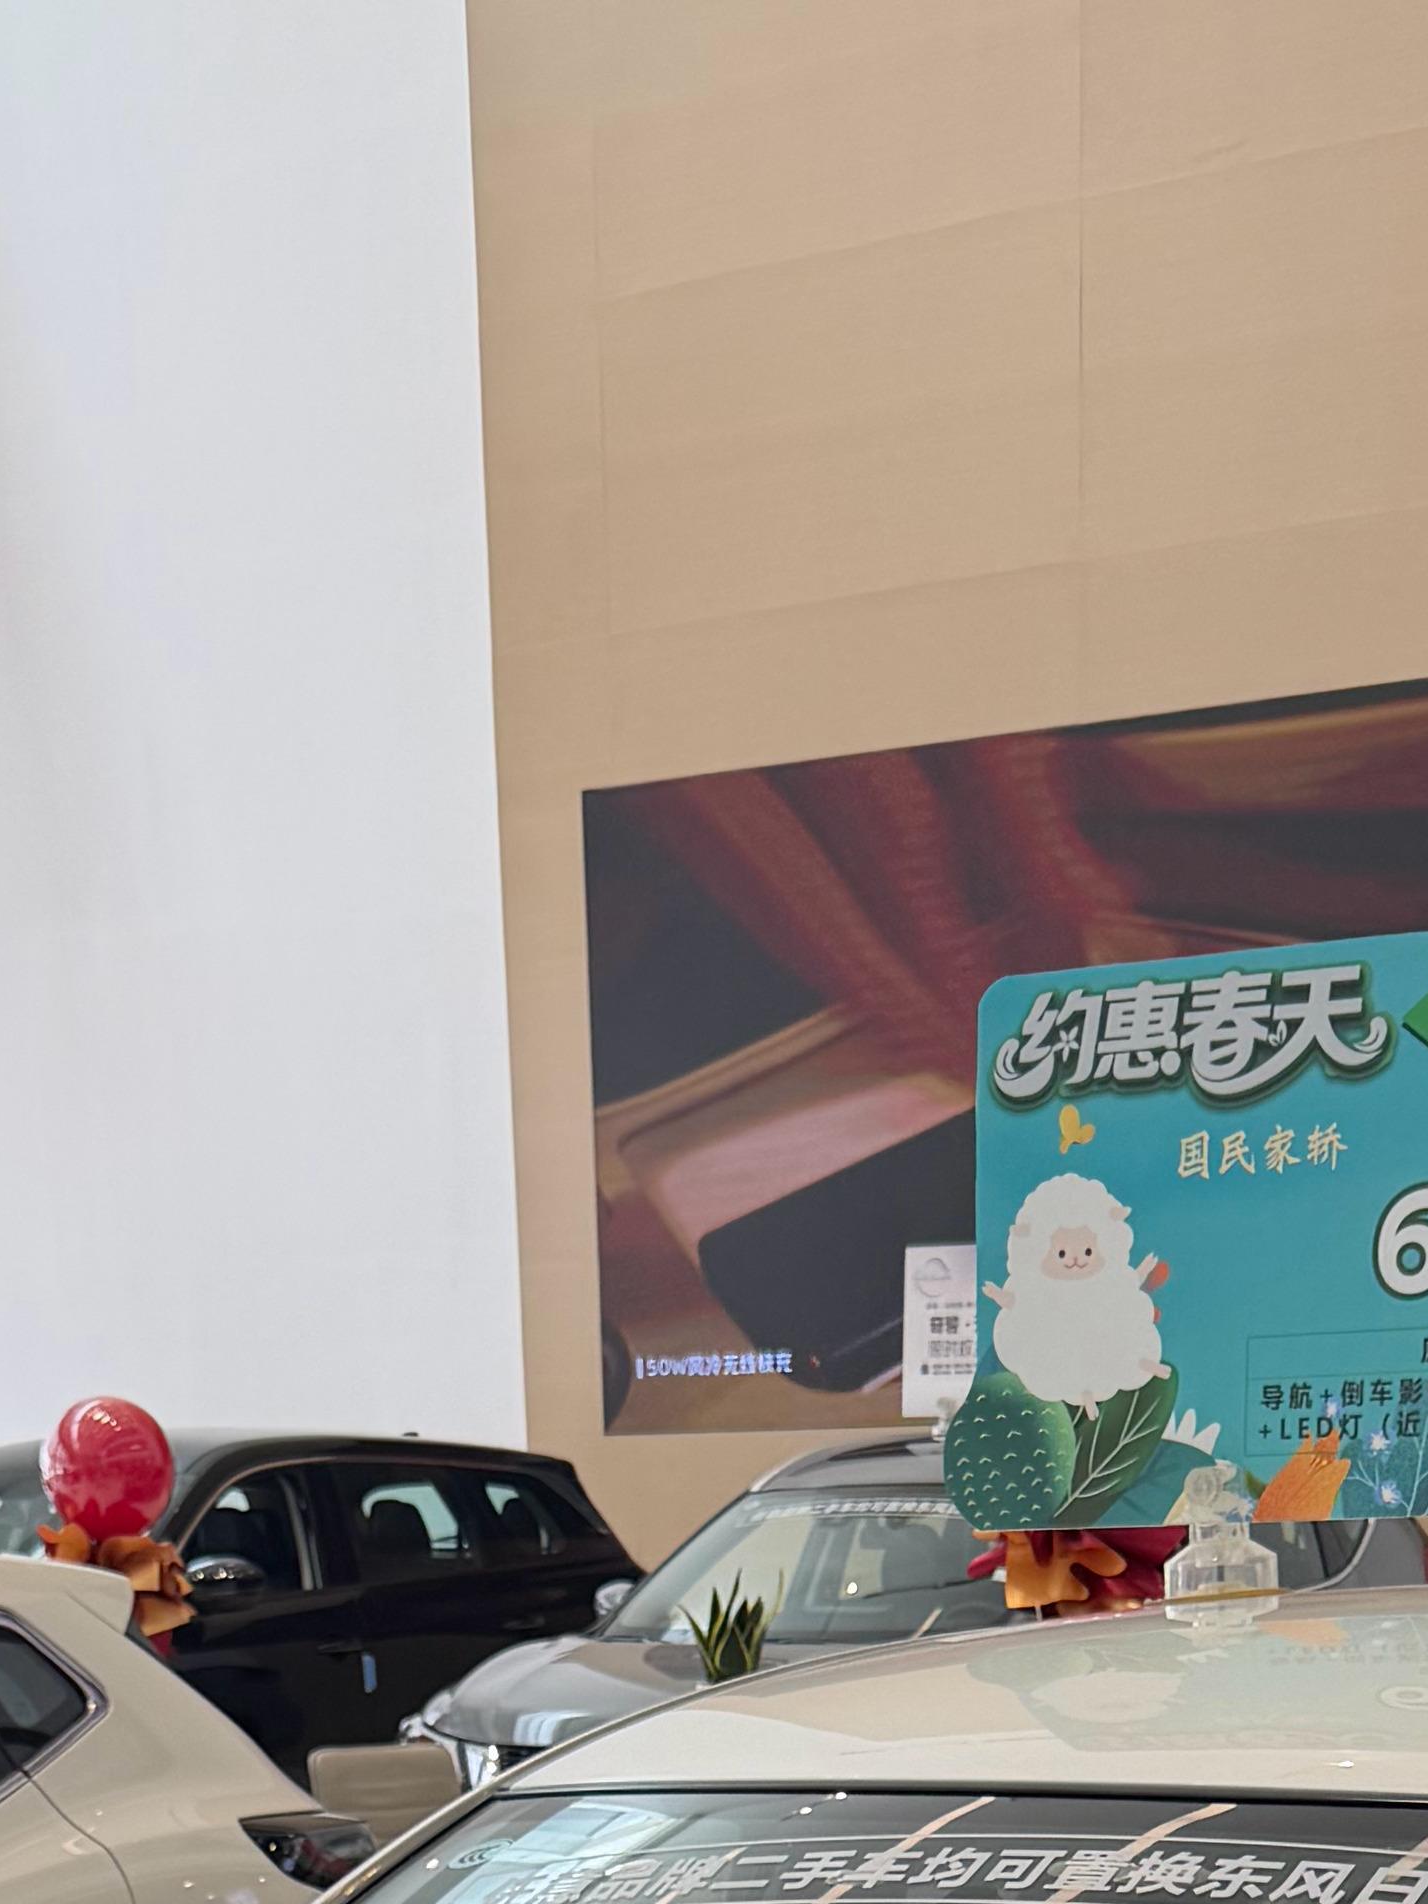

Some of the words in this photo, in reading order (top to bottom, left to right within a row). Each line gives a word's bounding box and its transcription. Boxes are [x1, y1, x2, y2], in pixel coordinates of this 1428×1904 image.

[994, 964, 1389, 1098] 约惠春天
[1177, 1121, 1349, 1180] 国民家轿
